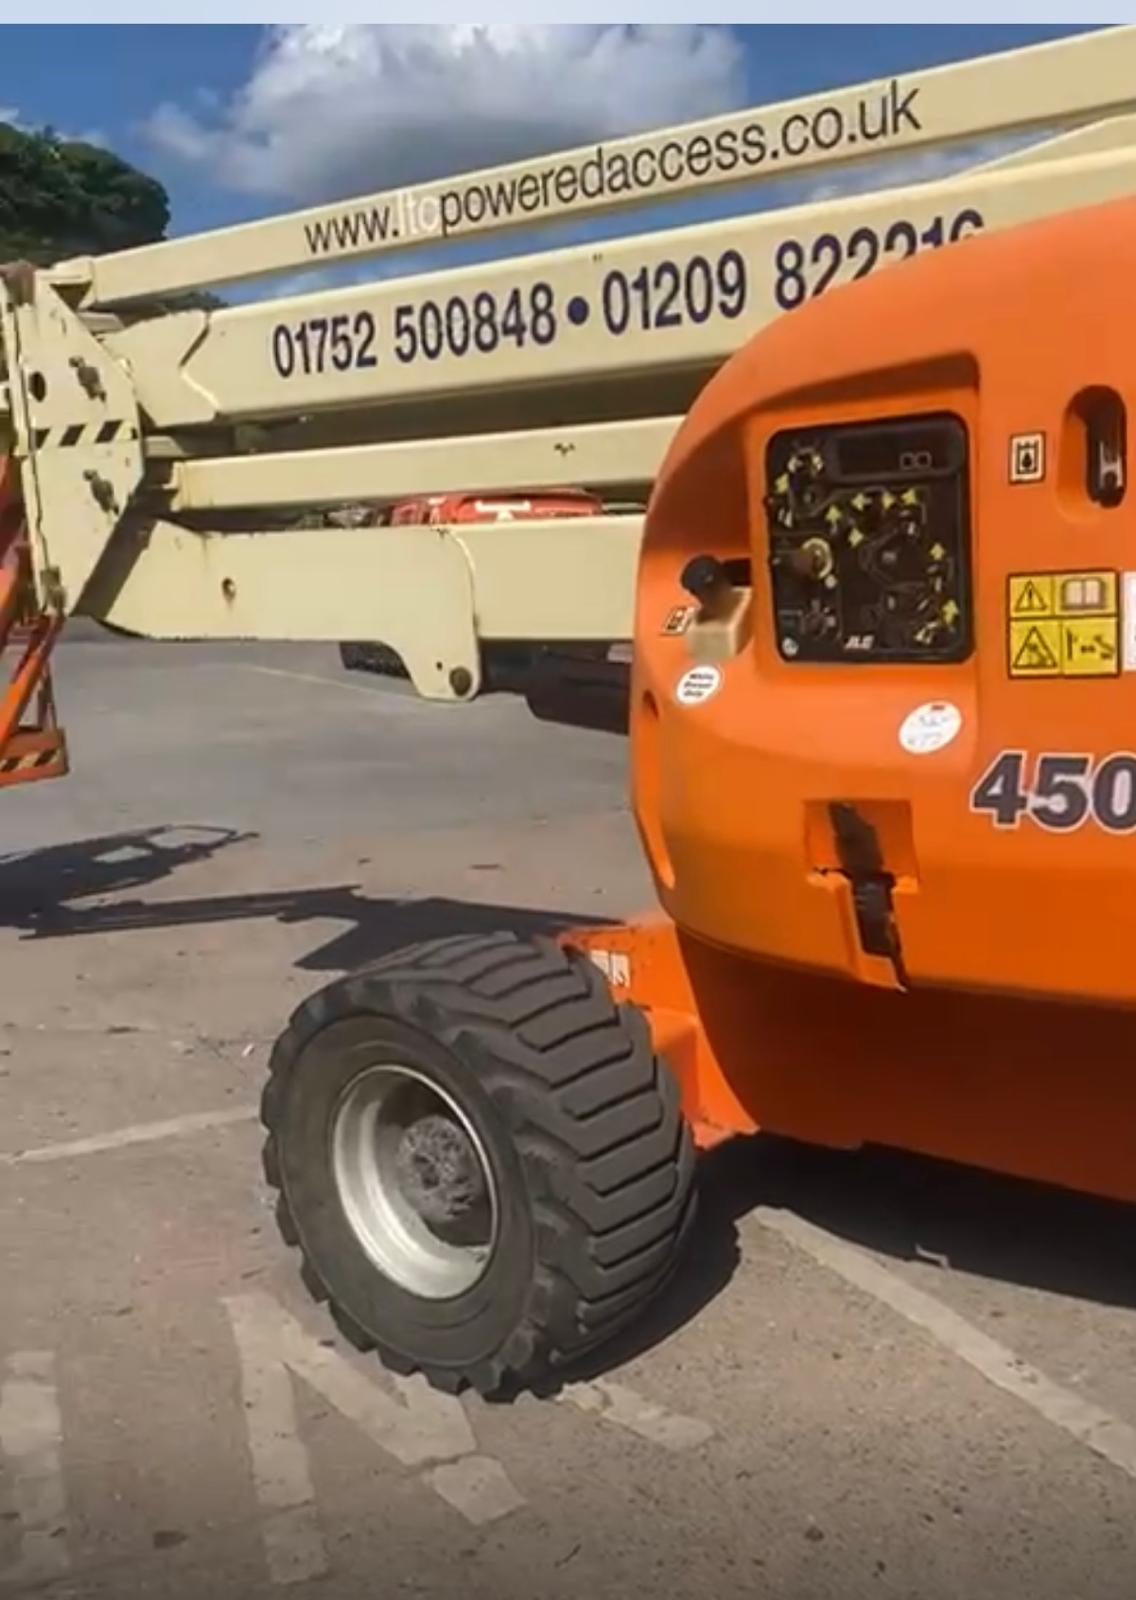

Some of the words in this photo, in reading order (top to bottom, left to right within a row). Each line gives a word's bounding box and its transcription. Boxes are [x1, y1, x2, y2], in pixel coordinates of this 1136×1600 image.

[272, 310, 378, 378] 01752
[394, 281, 557, 363] 500848
[602, 249, 748, 335] 01209
